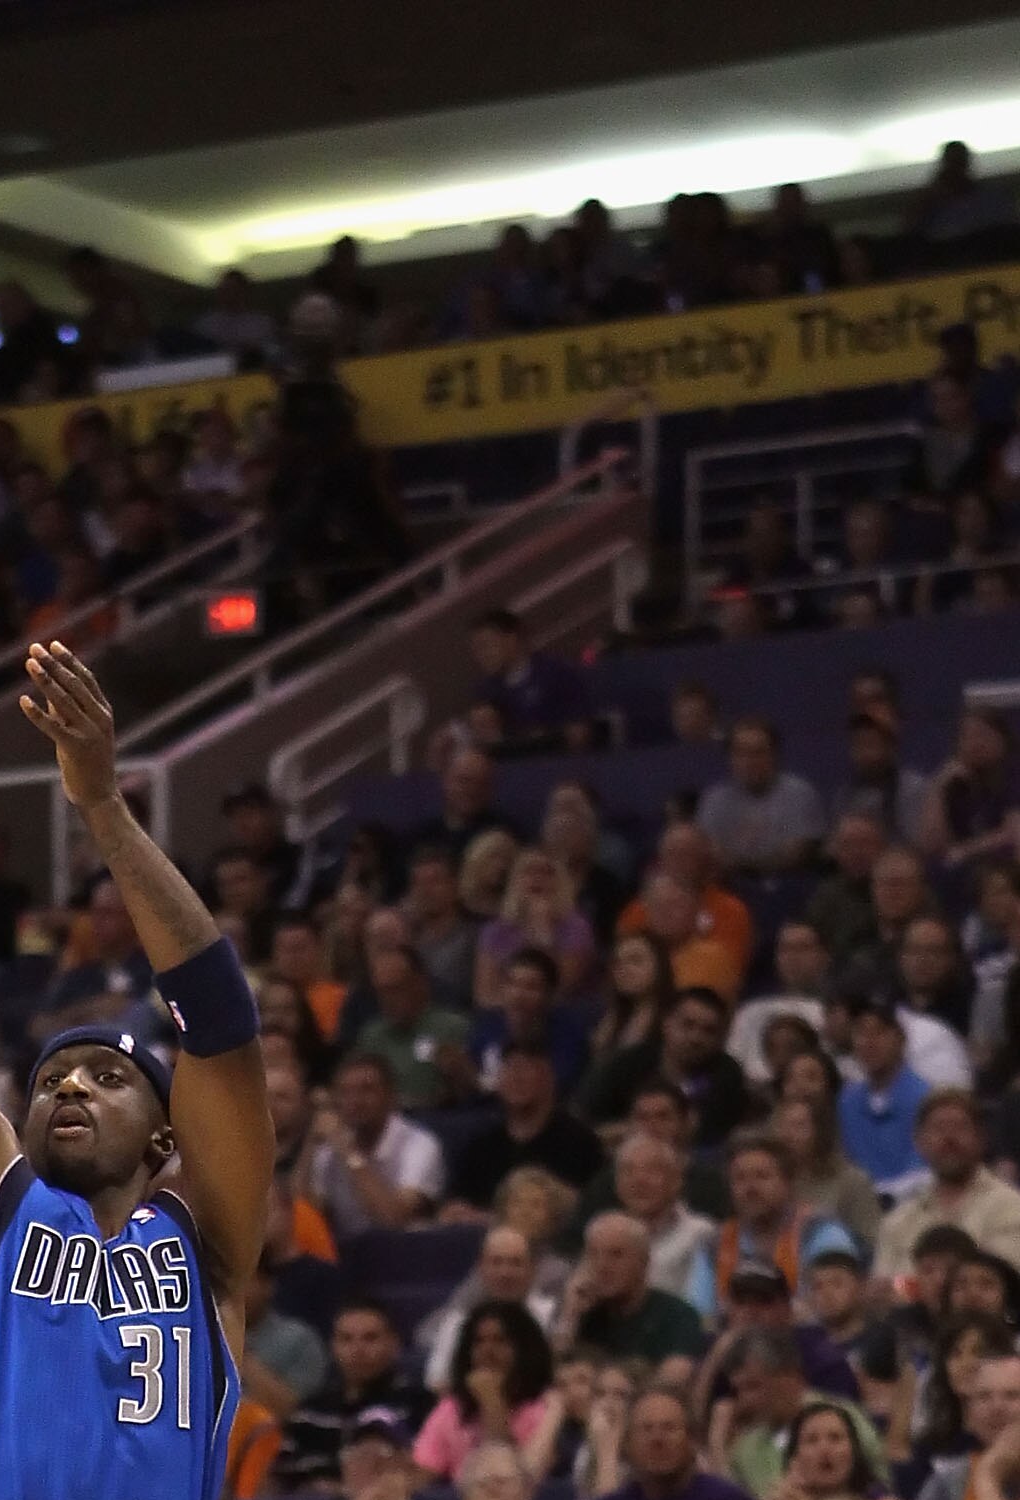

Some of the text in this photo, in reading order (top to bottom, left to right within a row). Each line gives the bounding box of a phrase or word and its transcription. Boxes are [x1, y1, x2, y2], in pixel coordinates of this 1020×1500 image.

[423, 357, 482, 411] #1
[498, 352, 553, 400] In
[563, 328, 775, 394] Identity
[791, 295, 942, 363] Theft
[118, 1323, 192, 1430] 31
